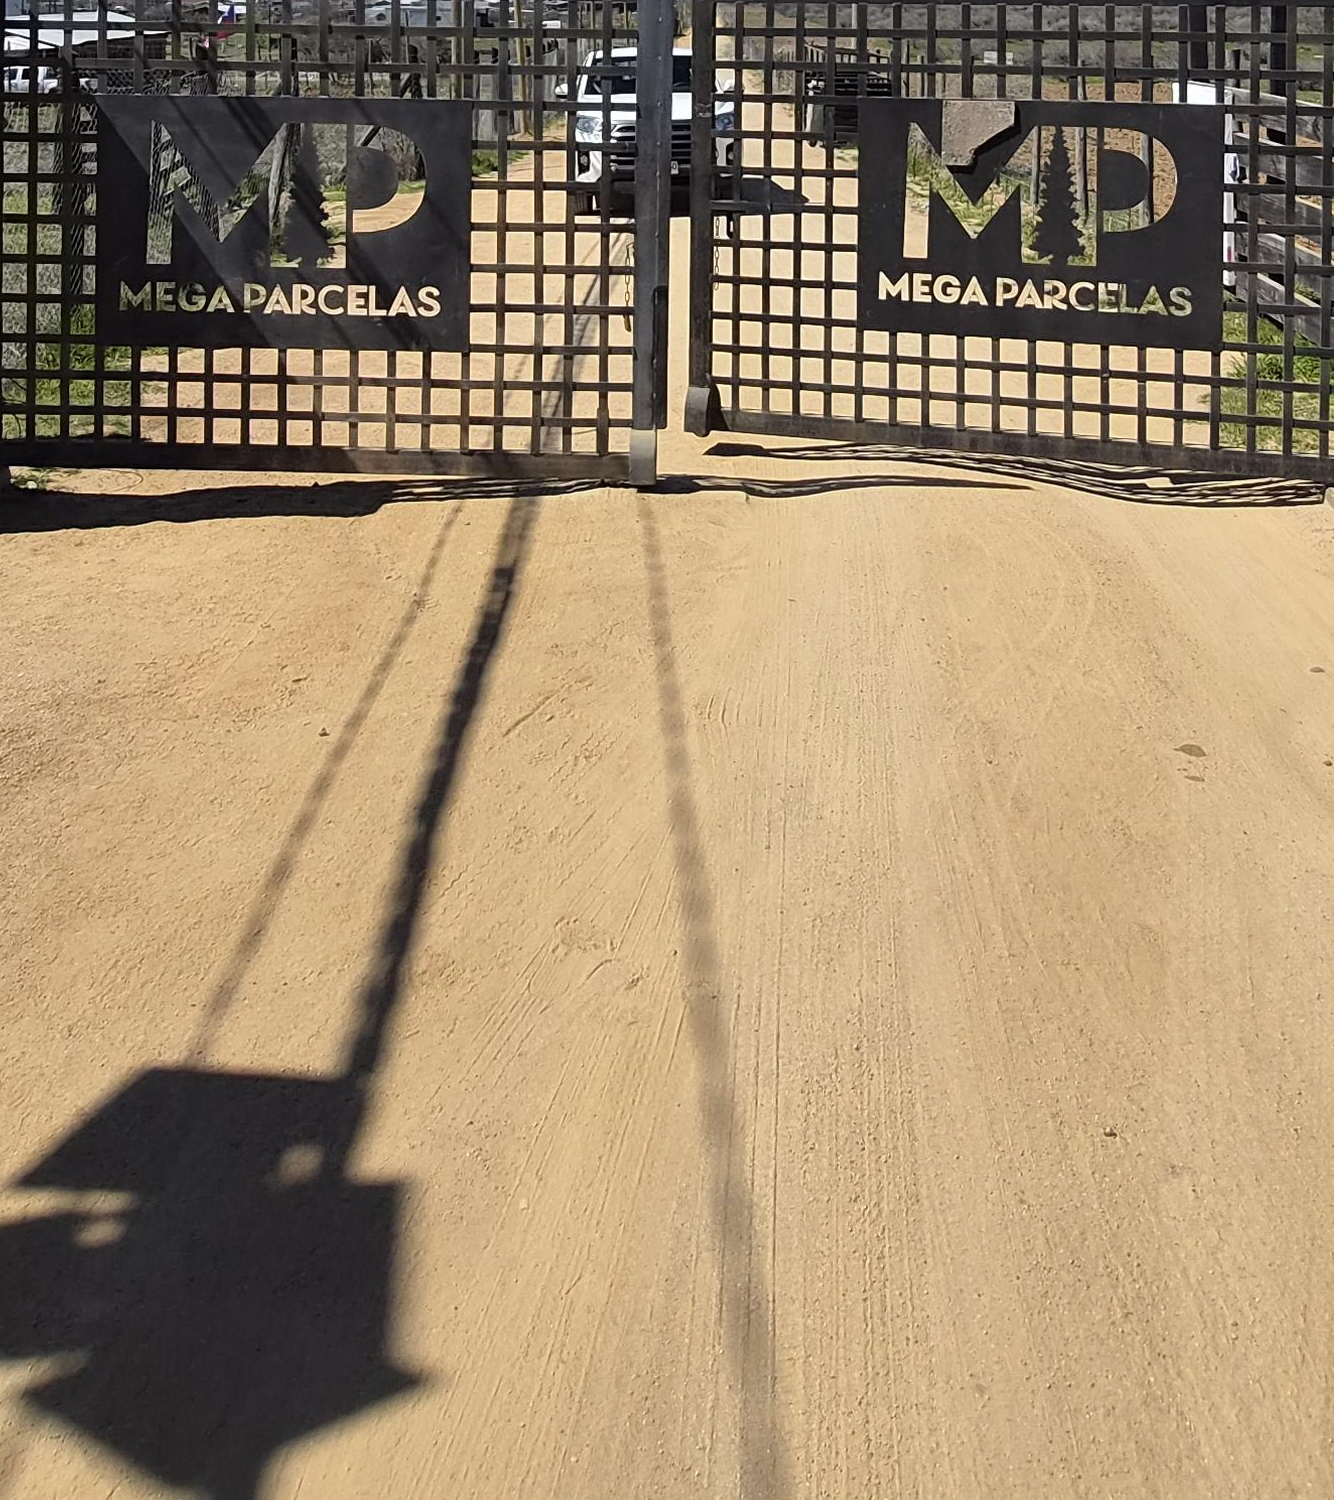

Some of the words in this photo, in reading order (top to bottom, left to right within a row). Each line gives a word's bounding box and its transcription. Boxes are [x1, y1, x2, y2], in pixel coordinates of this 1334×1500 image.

[119, 281, 235, 313] MEGA
[243, 284, 442, 318] PARCELAS
[878, 271, 987, 308] MEGA
[995, 276, 1193, 318] PARCELAS
